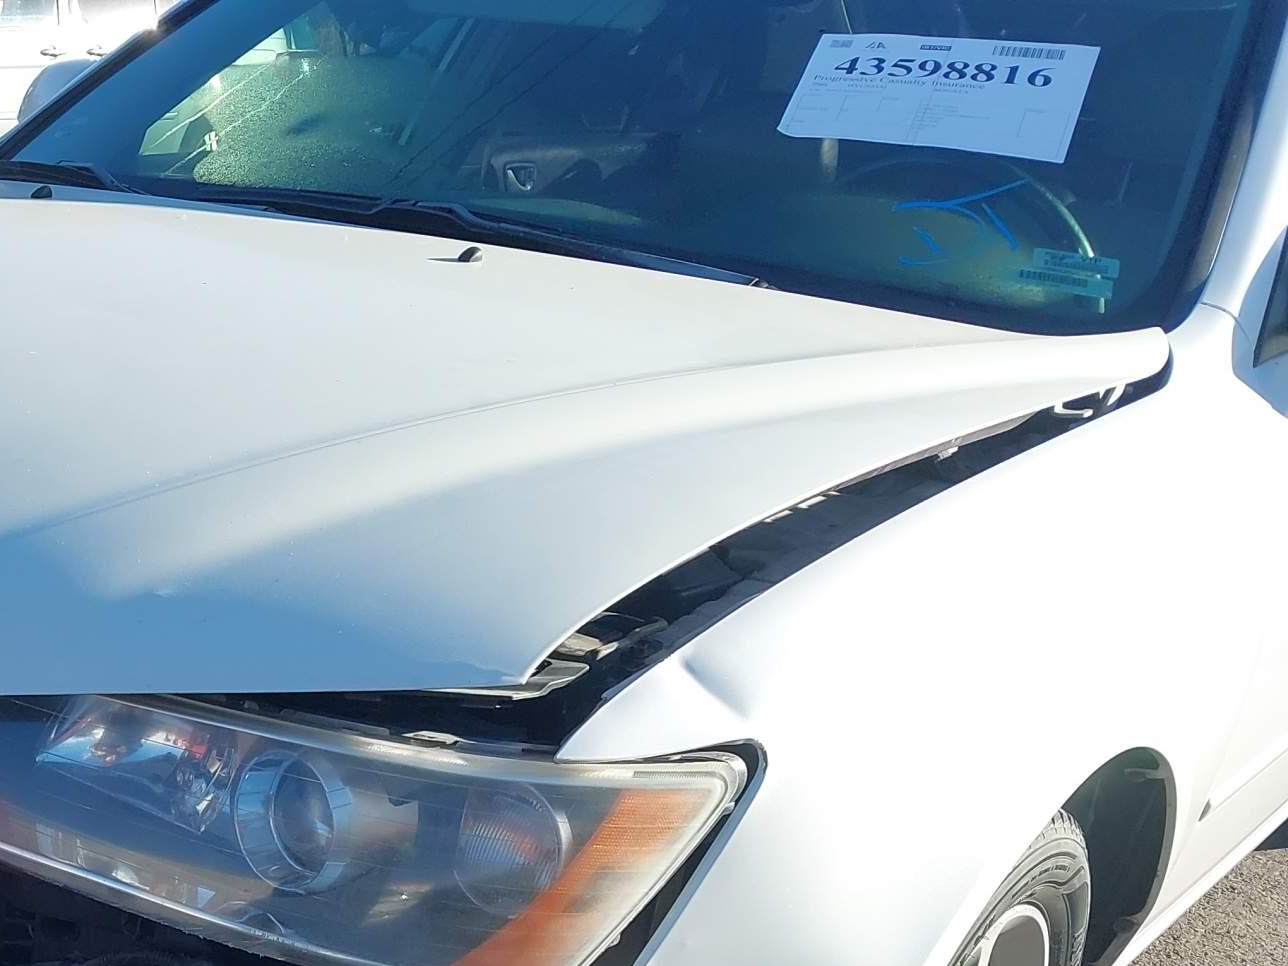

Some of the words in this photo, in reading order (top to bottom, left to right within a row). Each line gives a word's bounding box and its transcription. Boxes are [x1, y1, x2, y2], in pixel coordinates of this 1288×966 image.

[813, 74, 877, 83] Progressive
[879, 76, 927, 88] Casualty
[931, 78, 986, 90] Insurance
[834, 56, 1056, 88] 43598816
